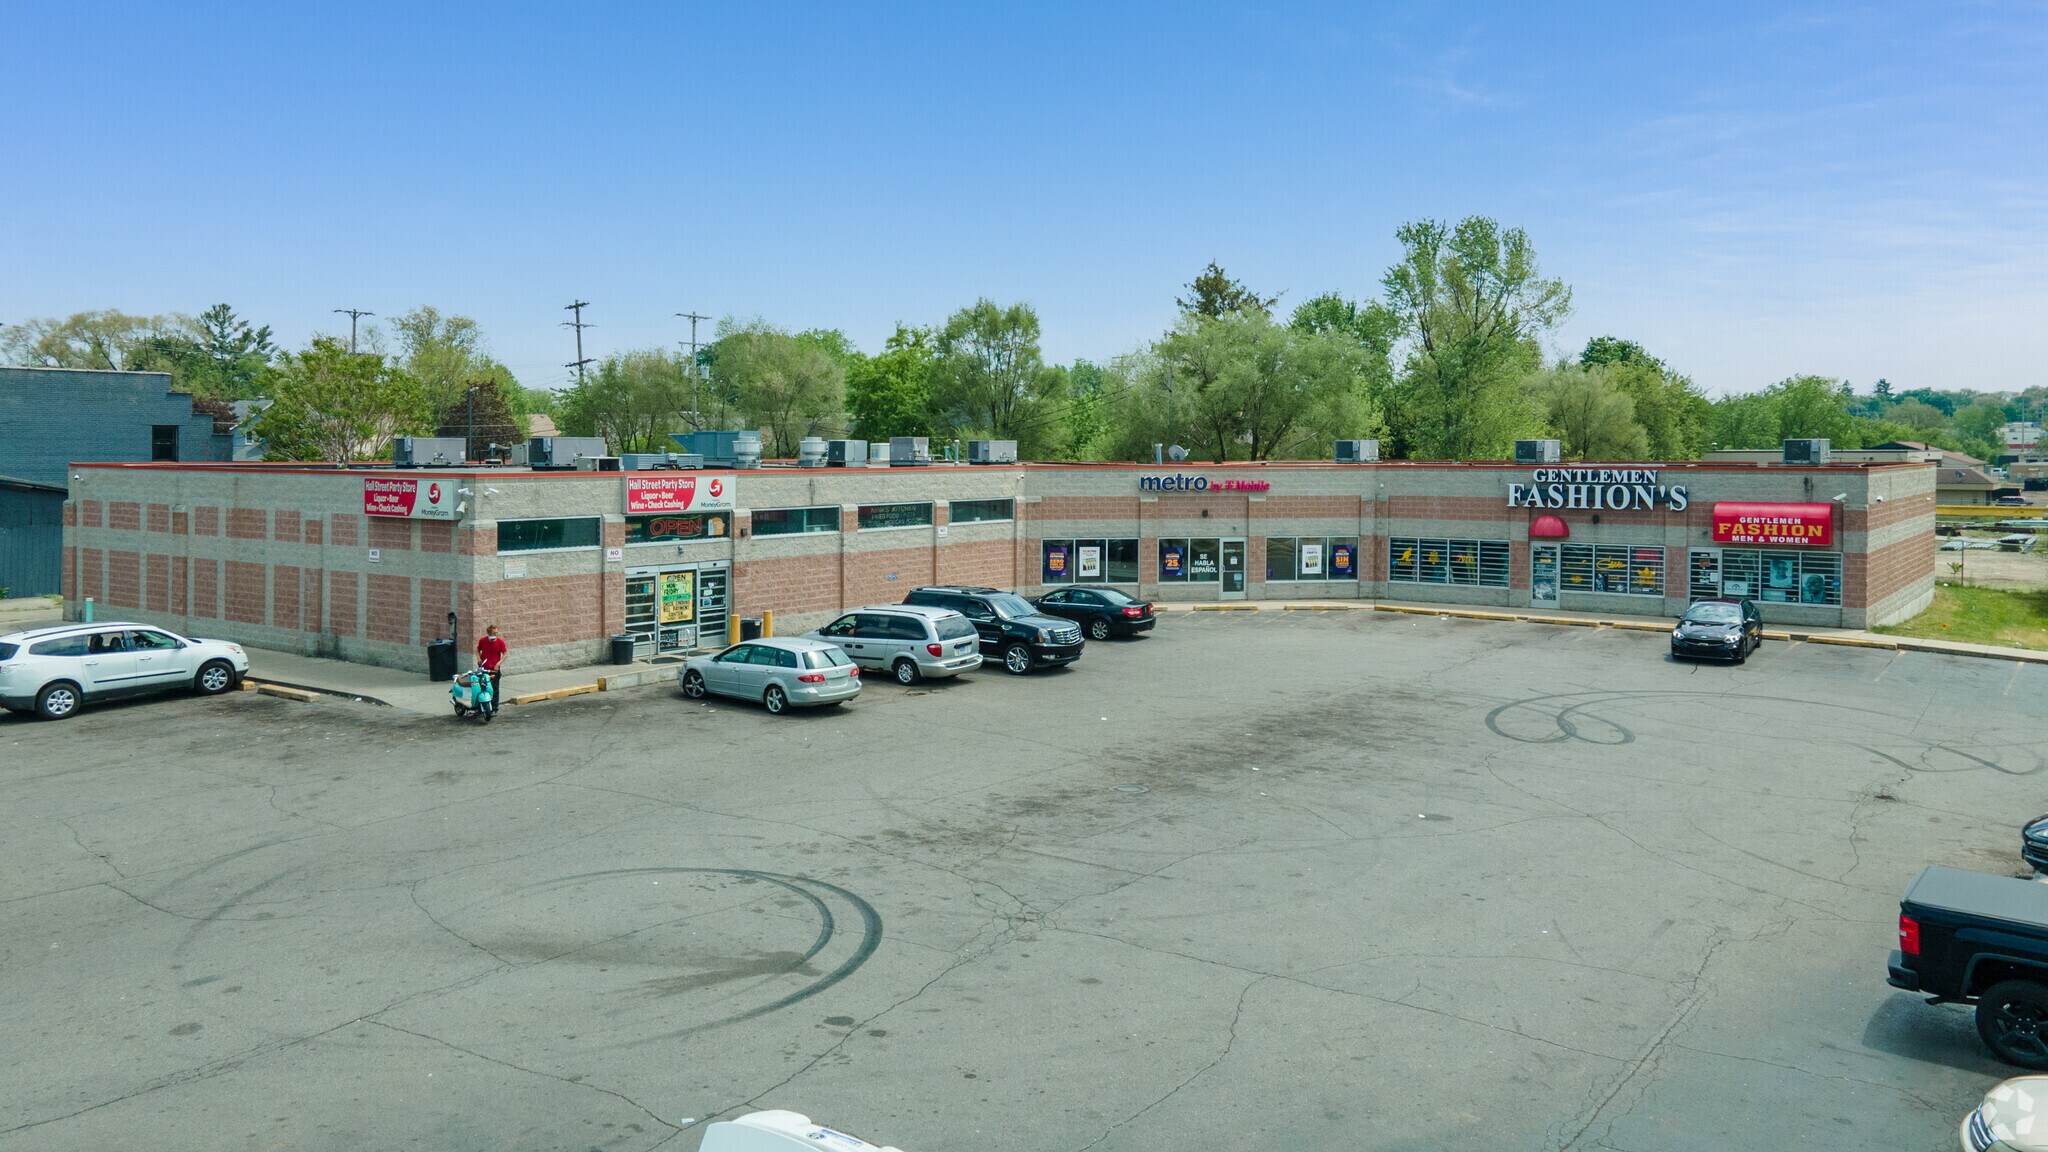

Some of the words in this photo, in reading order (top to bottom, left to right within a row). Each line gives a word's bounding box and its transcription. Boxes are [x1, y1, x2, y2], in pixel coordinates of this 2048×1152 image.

[1140, 473, 1208, 491] metro
[1533, 468, 1657, 484] GENTLEMEN
[375, 482, 390, 492] Street
[390, 482, 402, 494] Party
[403, 482, 416, 492] Store
[629, 480, 641, 490] Hall
[641, 480, 661, 491] Street
[661, 479, 678, 491] Party
[678, 479, 695, 489] Store
[661, 490, 674, 499] Beer
[1507, 483, 1688, 512] FASHION'S
[630, 502, 645, 510] Wine
[647, 500, 663, 509] Check
[664, 499, 684, 510] Cashing
[650, 518, 702, 536] OPEN
[1718, 523, 1823, 537] FASHION
